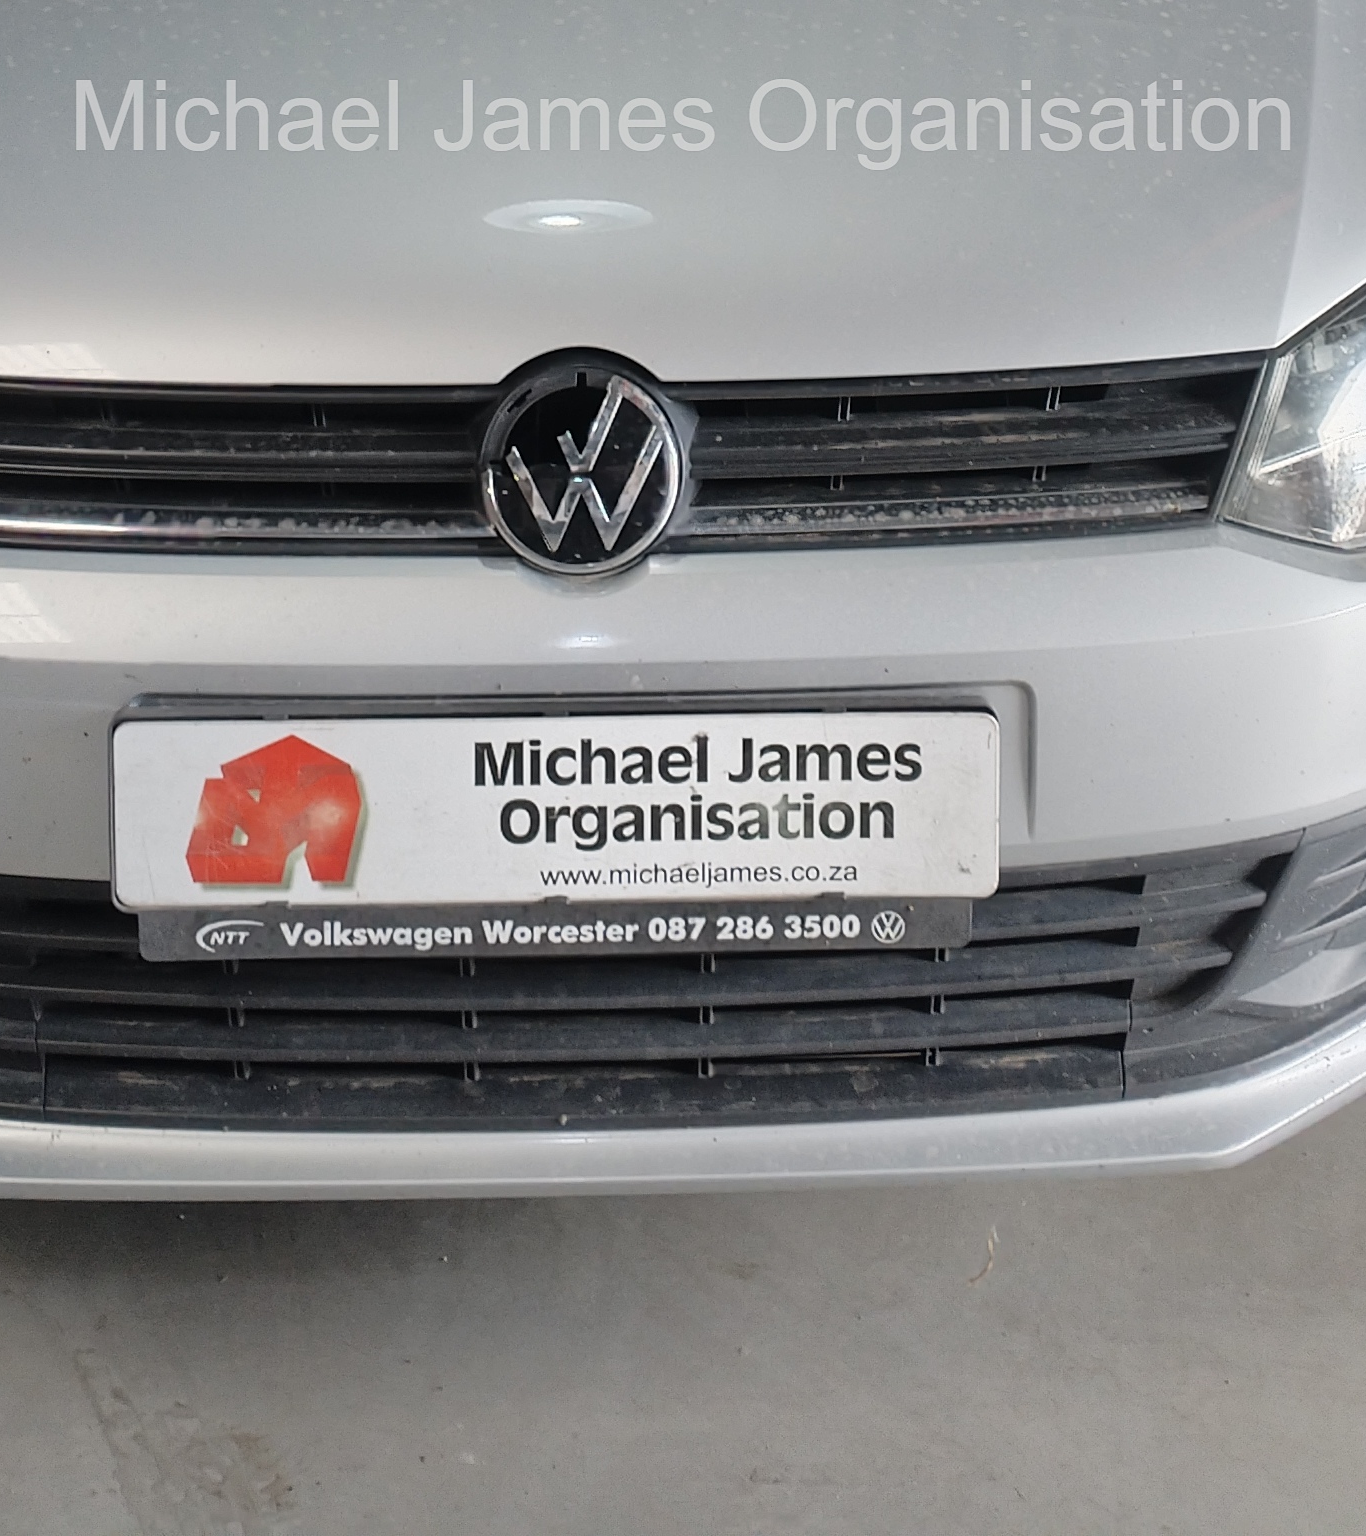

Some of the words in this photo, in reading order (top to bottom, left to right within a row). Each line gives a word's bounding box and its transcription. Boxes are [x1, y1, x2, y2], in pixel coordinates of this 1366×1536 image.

[473, 736, 709, 787] Michael
[729, 740, 923, 784] James
[499, 796, 896, 850] Organisation
[539, 861, 859, 888] www.michaeljames.co.za
[210, 931, 250, 945] NTT
[280, 921, 473, 951] Volkswagen
[482, 918, 641, 944] Worcester
[647, 916, 705, 942] 087
[715, 915, 774, 941] 286
[783, 913, 861, 940] 3500
